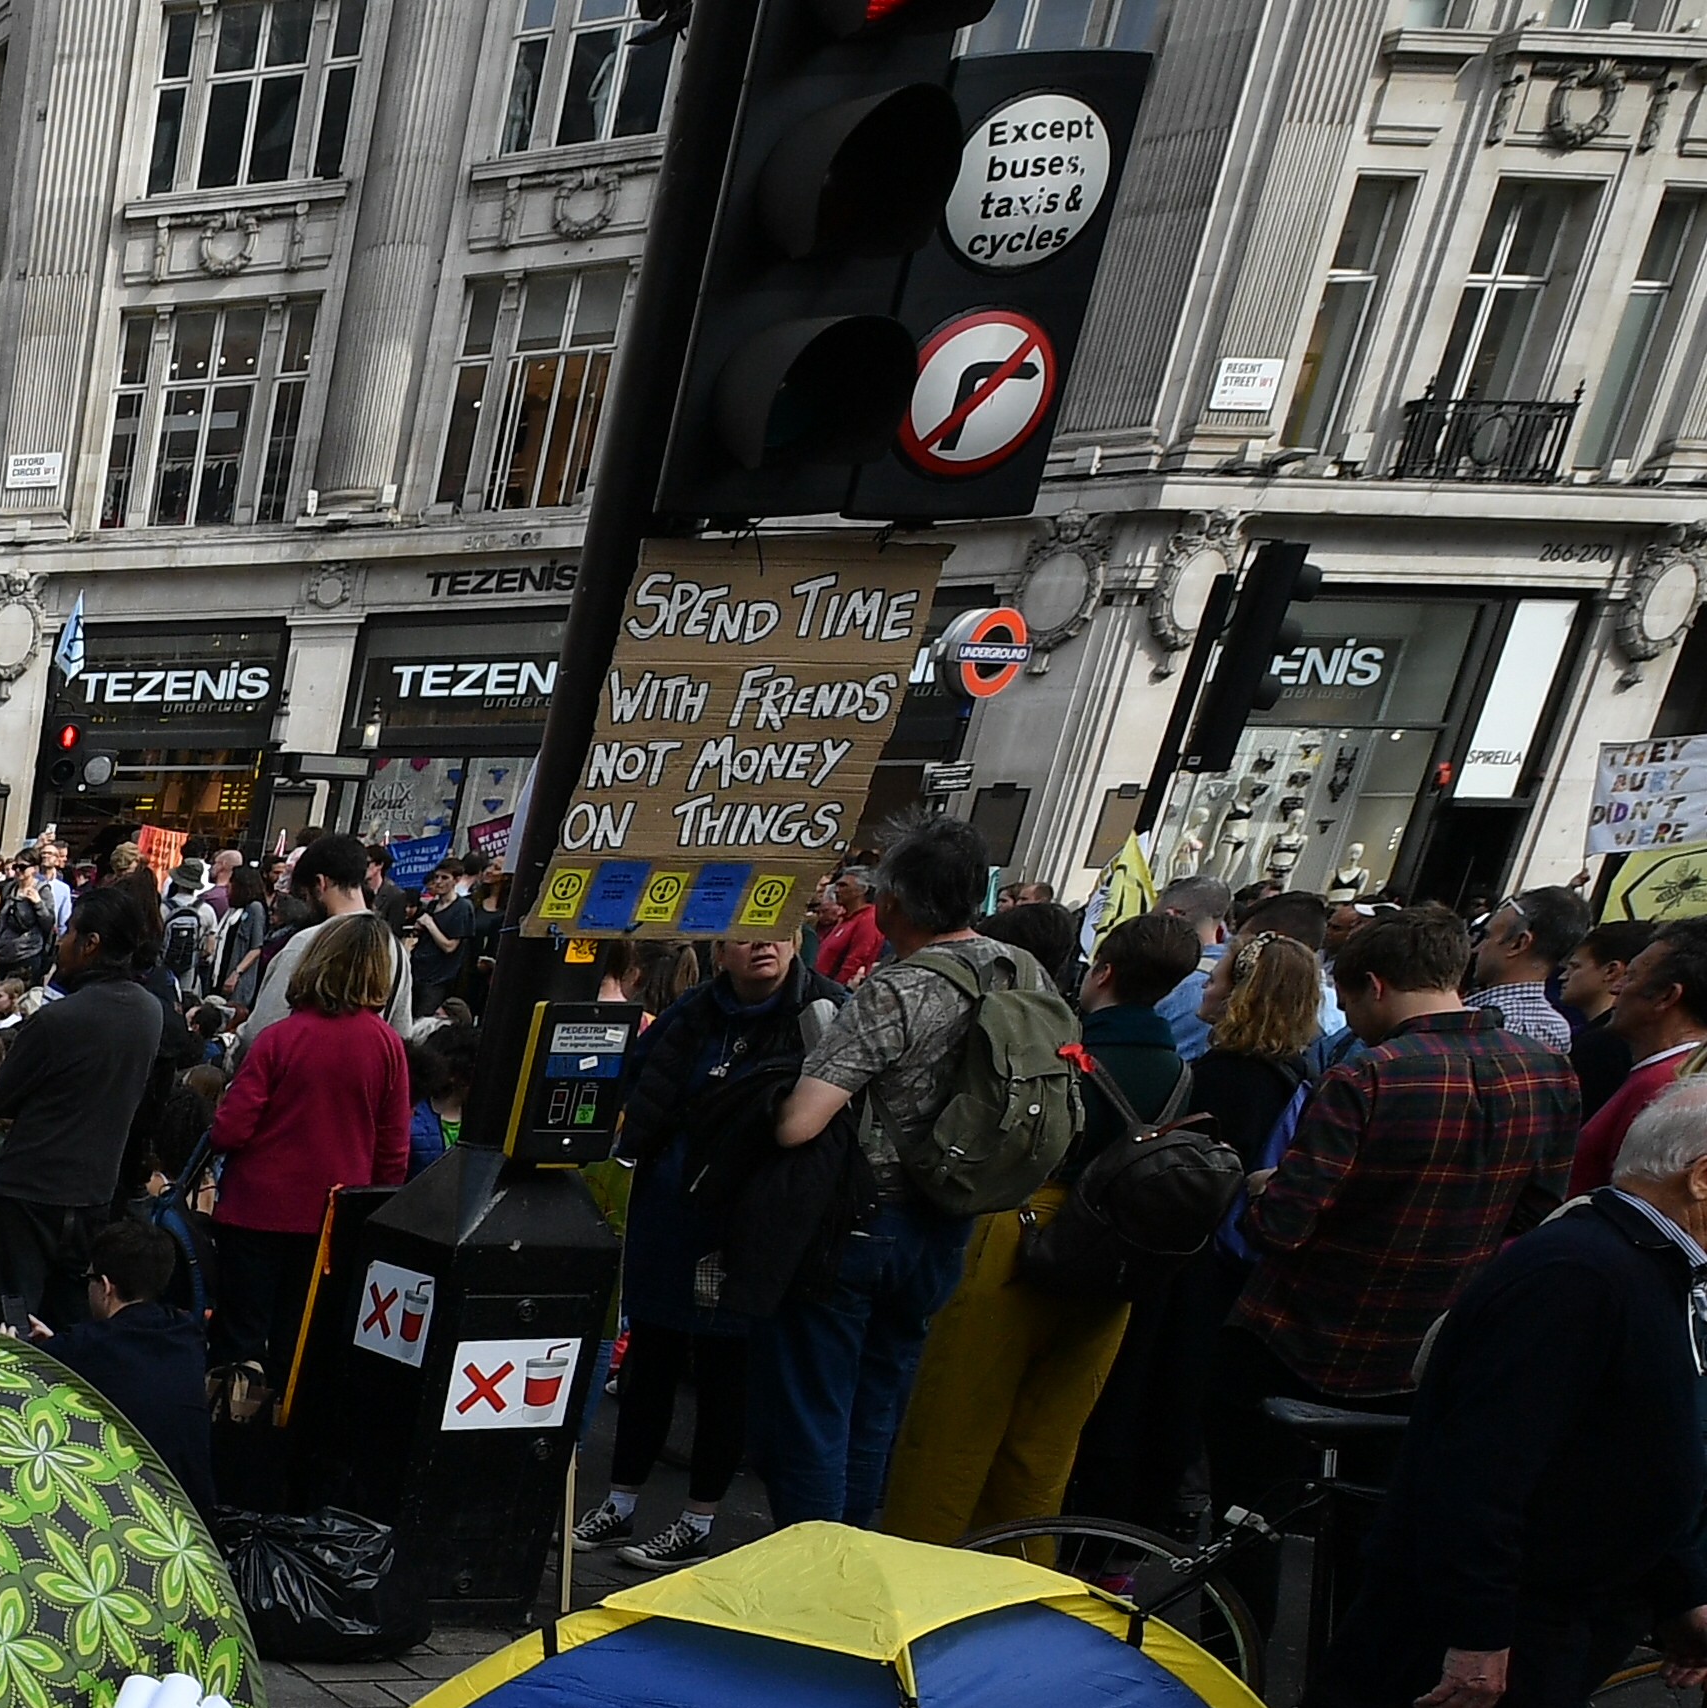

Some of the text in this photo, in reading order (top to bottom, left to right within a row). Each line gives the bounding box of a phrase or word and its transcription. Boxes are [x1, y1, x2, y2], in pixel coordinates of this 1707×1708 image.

[988, 115, 1094, 147] Except
[987, 155, 1086, 182] buses,
[980, 184, 1083, 219] taxis &
[968, 224, 1069, 259] cycles
[1222, 376, 1258, 387] STREET
[1226, 363, 1262, 374] REGENT
[1539, 543, 1614, 564] 266-270
[625, 572, 920, 645] SPEND TIME
[959, 645, 1027, 659] UNDERGROUND
[609, 668, 710, 724] WITH
[727, 665, 898, 732] FRIENDS
[586, 735, 853, 792] NOT MONEY
[1466, 749, 1522, 766] SPIRELLA
[1605, 739, 1691, 767] THEY
[369, 783, 415, 800] MIX
[371, 798, 406, 810] and
[362, 810, 415, 821] MATCH
[562, 794, 850, 853] ON THINGS.
[1591, 796, 1687, 827] DIDN'T
[561, 1026, 619, 1034] PEDESTRIA
